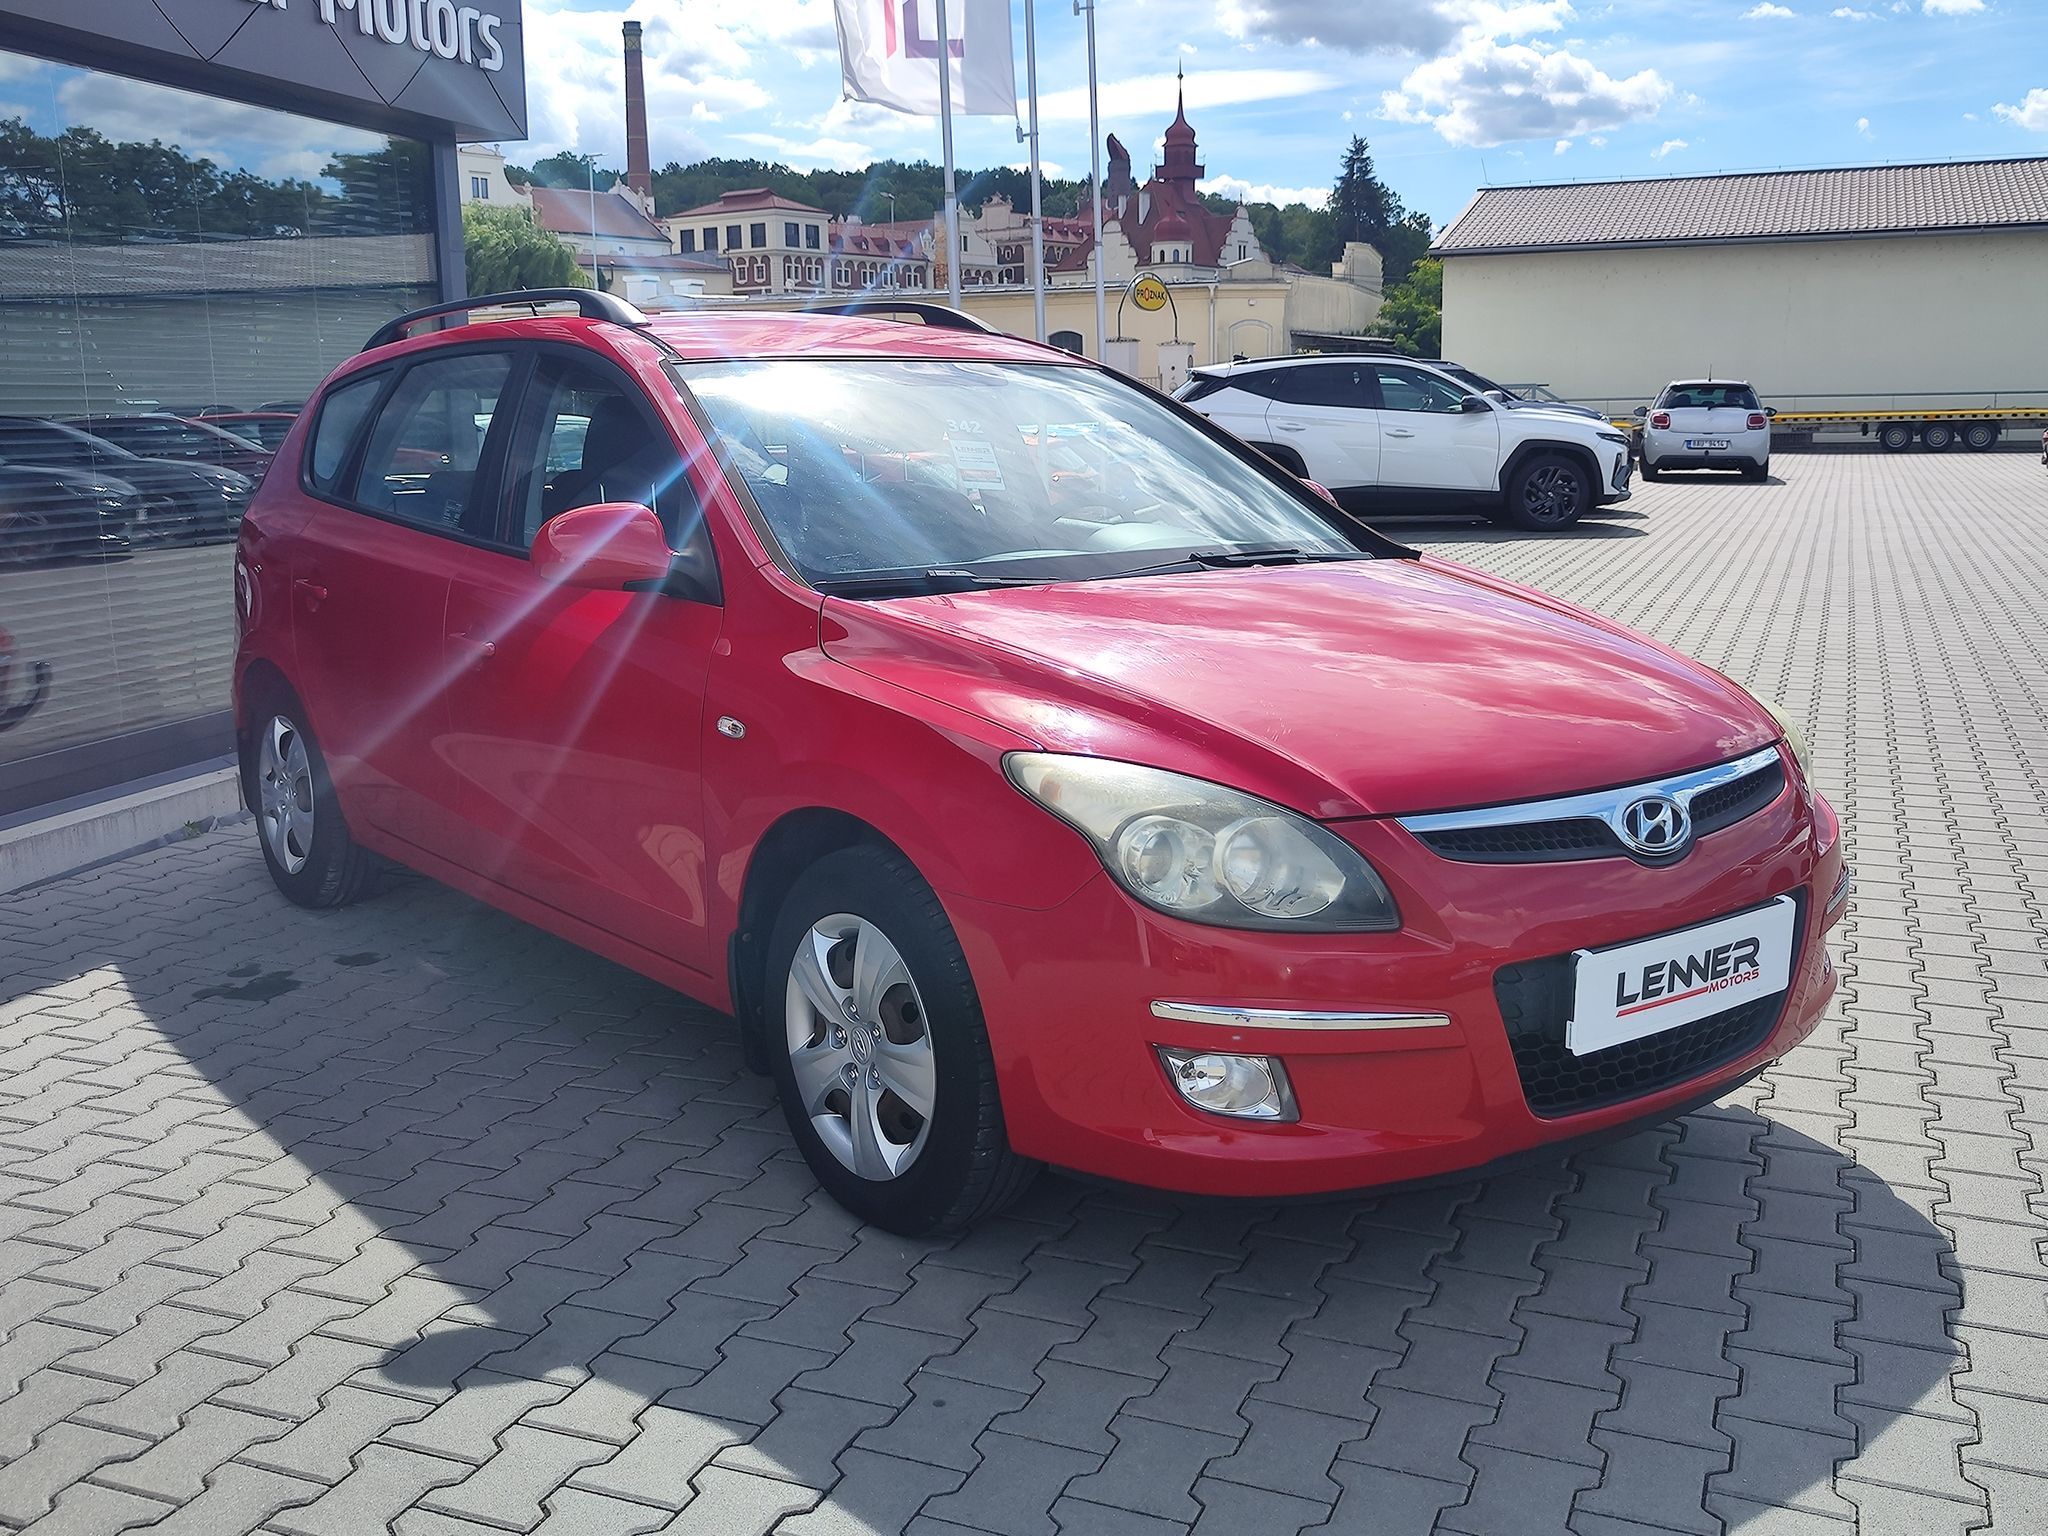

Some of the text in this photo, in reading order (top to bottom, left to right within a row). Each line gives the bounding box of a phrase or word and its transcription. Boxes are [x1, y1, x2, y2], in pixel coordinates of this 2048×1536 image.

[1136, 287, 1166, 301] PROZNAK
[946, 418, 984, 434] 342
[1616, 936, 1760, 1008] LENNER
[1708, 968, 1760, 994] MOTORS
